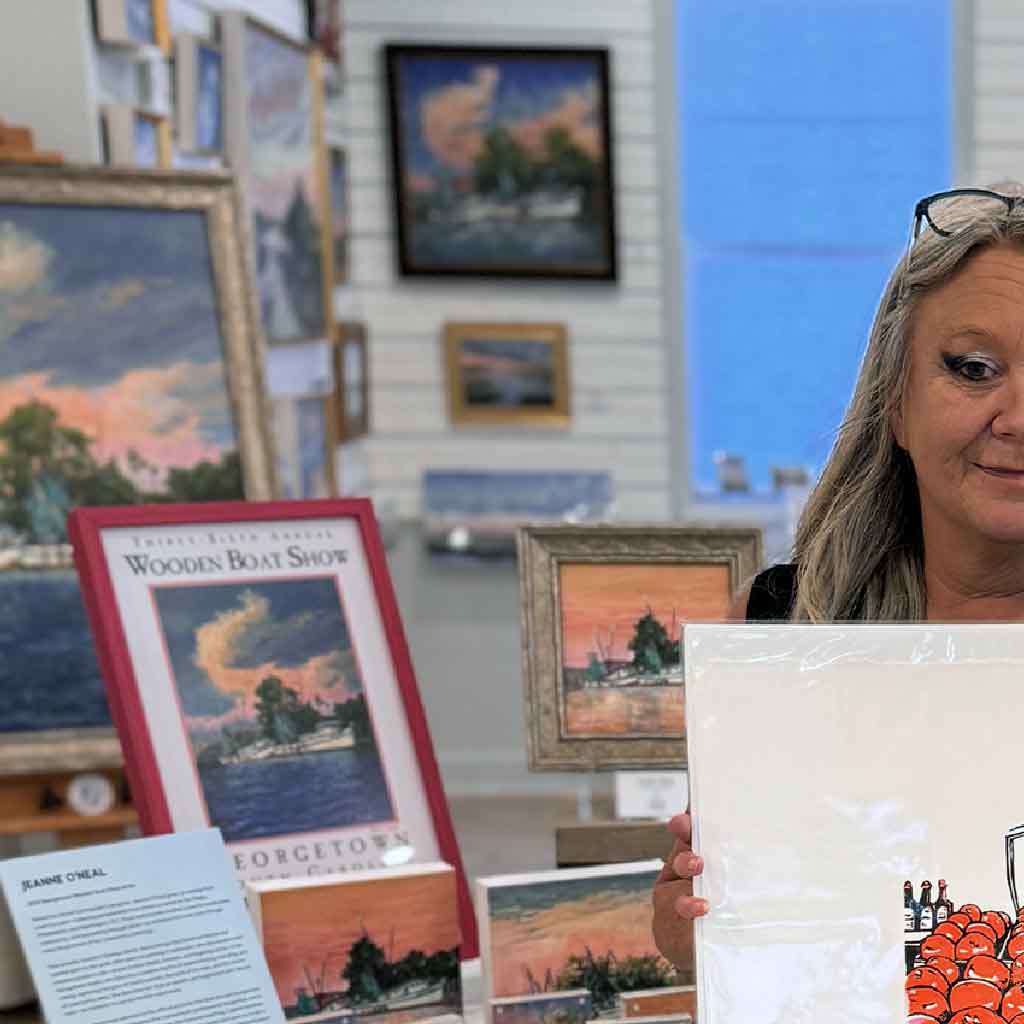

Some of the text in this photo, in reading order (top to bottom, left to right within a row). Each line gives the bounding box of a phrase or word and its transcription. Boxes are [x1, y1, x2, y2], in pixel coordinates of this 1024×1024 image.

[124, 545, 349, 576] WOODEN BOAT SHOW
[233, 831, 410, 870] EORGETOWN
[21, 867, 108, 893] JEANNE O'NEAL
